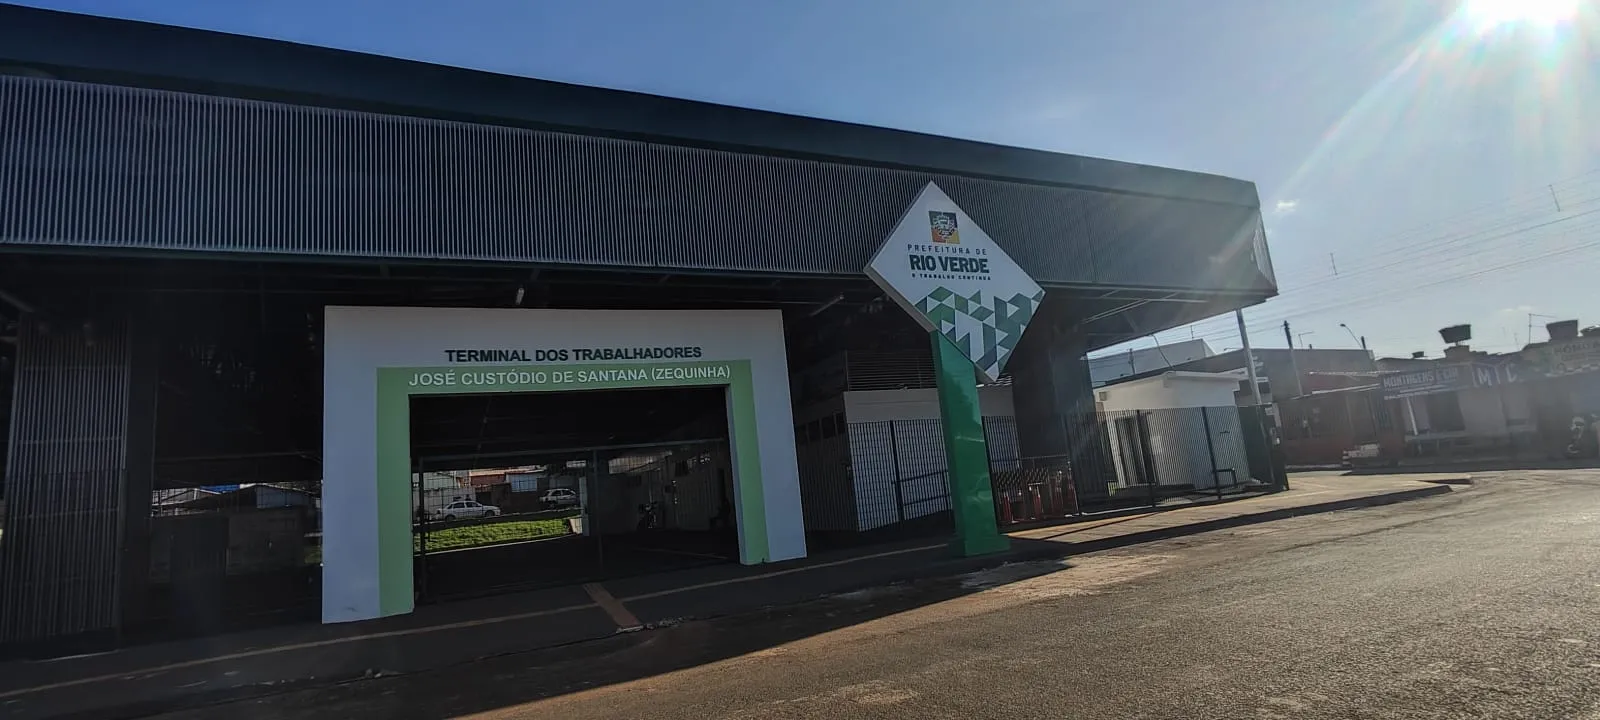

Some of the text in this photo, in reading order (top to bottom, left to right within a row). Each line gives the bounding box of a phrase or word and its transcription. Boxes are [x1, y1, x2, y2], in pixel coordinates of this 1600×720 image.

[907, 243, 970, 254] PREFEITURA
[909, 254, 990, 273] RIO VERDE
[444, 346, 702, 362] TERMINAL DOS TRABALHADORES
[408, 364, 731, 386] JOSÉ CUSTÓDIO DE SANTANA (ZEQUINHA)
